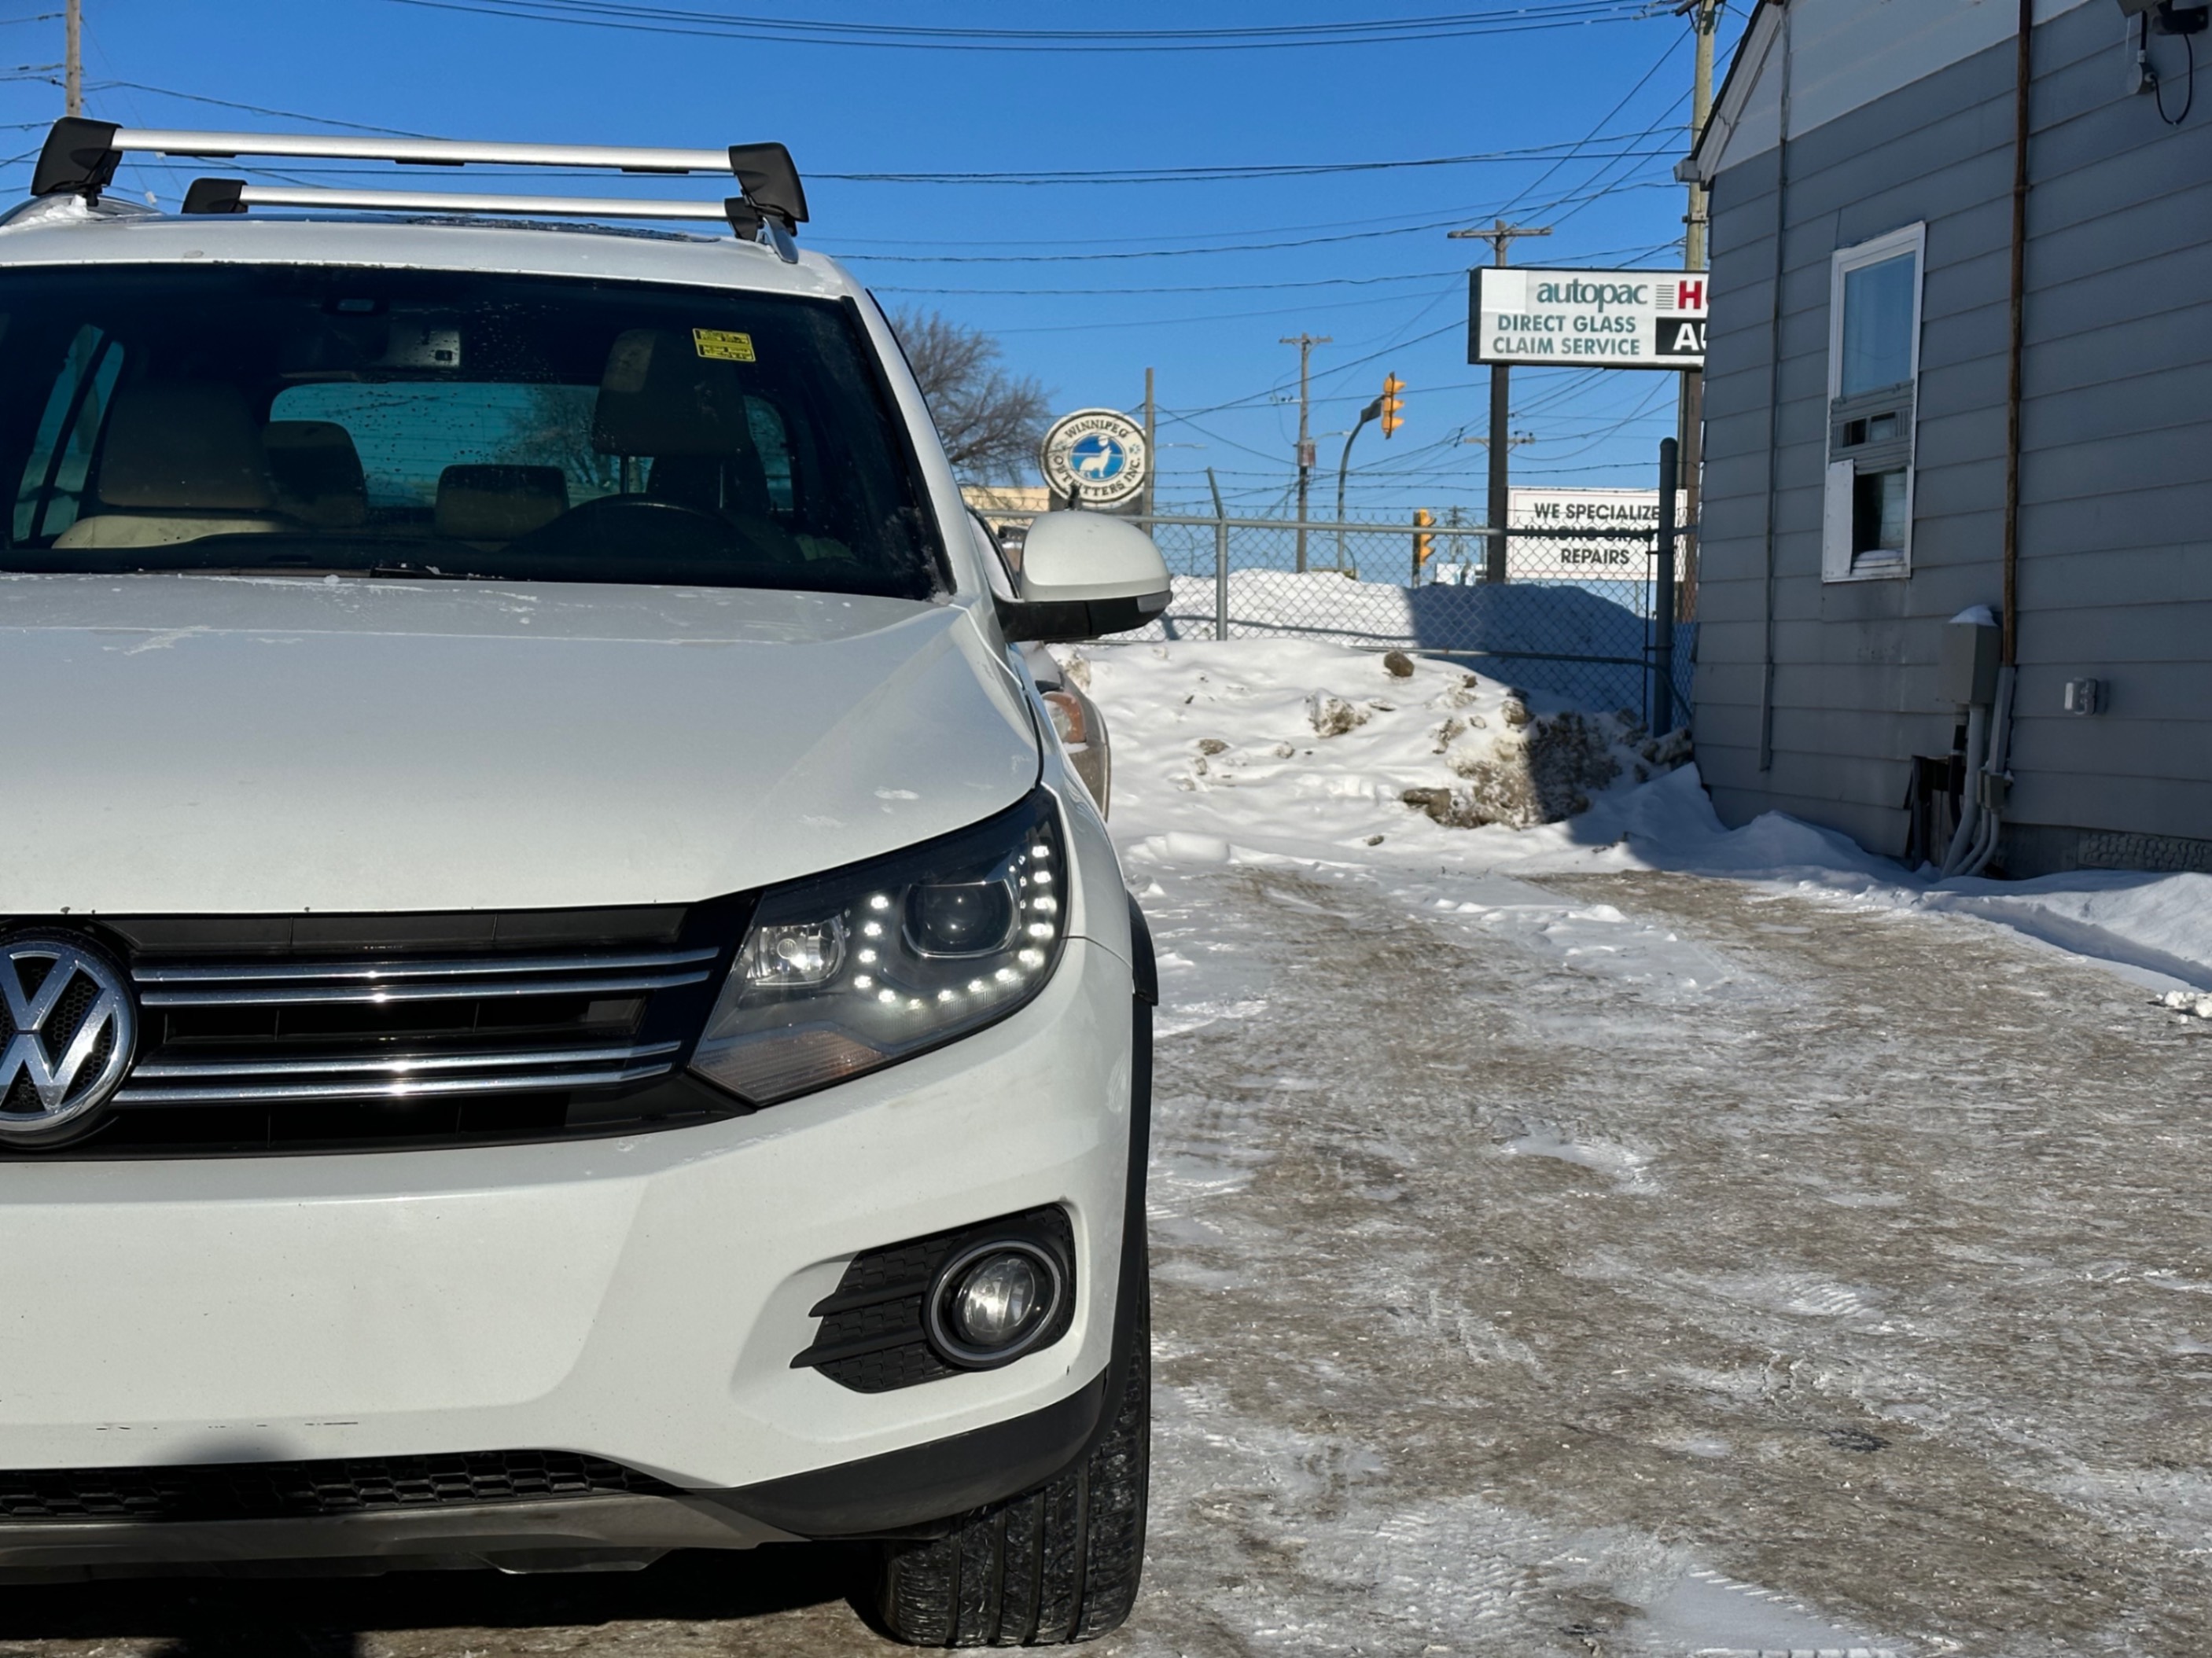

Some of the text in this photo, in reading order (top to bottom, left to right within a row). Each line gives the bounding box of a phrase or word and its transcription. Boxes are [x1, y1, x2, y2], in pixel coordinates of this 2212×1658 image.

[1537, 278, 1648, 313] autopac
[1498, 314, 1636, 333] DIRECT GLASS
[1492, 336, 1640, 355] CLAIM SERVICE
[1064, 419, 1129, 439] WINNIPEG
[1053, 455, 1126, 497] OUTFITTERS
[1534, 503, 1660, 520] WE SPECIALIZE
[1561, 548, 1630, 565] REPAIRS
